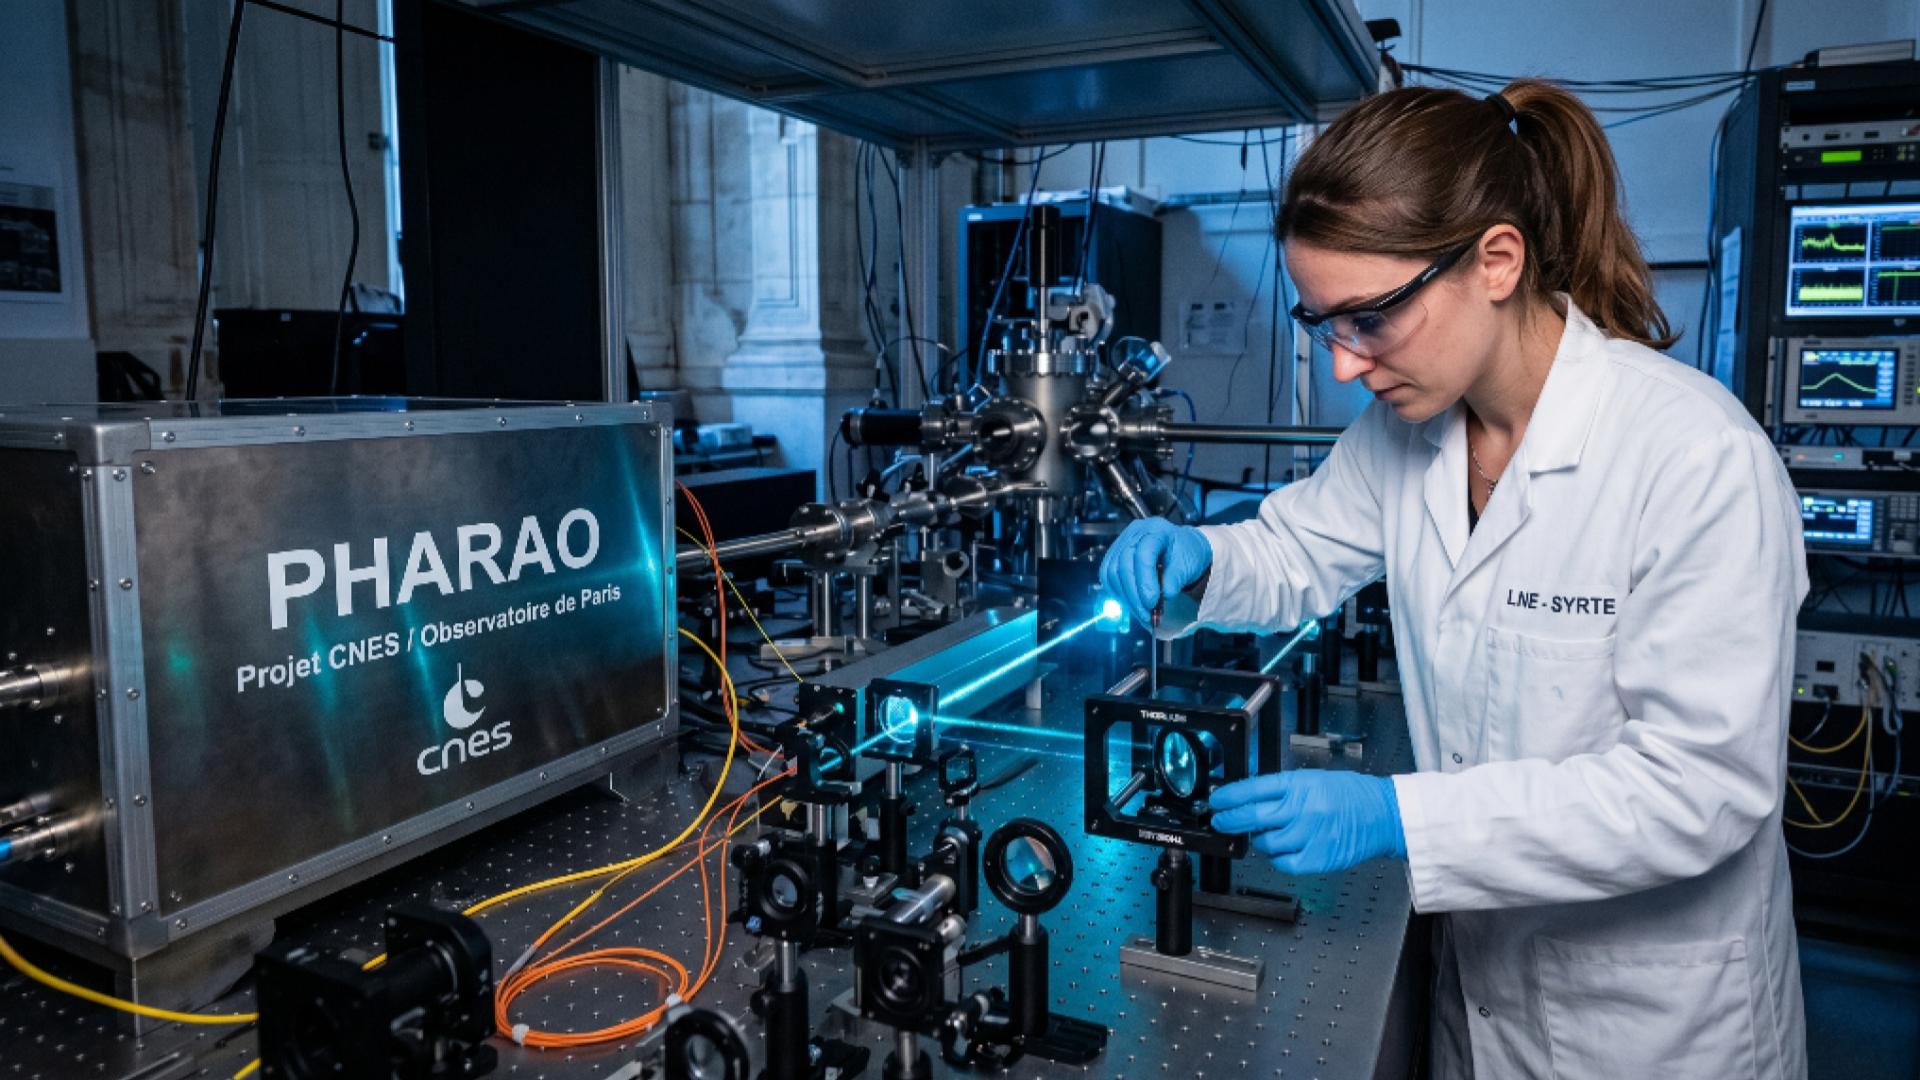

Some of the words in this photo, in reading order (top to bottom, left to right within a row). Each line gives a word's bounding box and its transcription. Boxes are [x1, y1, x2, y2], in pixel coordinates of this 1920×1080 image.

[267, 508, 600, 630] PHARAO
[1551, 595, 1616, 615] SYRTE
[237, 651, 321, 693] Projet
[328, 632, 400, 670] CNES
[420, 600, 550, 648] Observatoire
[555, 594, 576, 614] de
[581, 583, 622, 608] Paris
[416, 720, 513, 776] cnes
